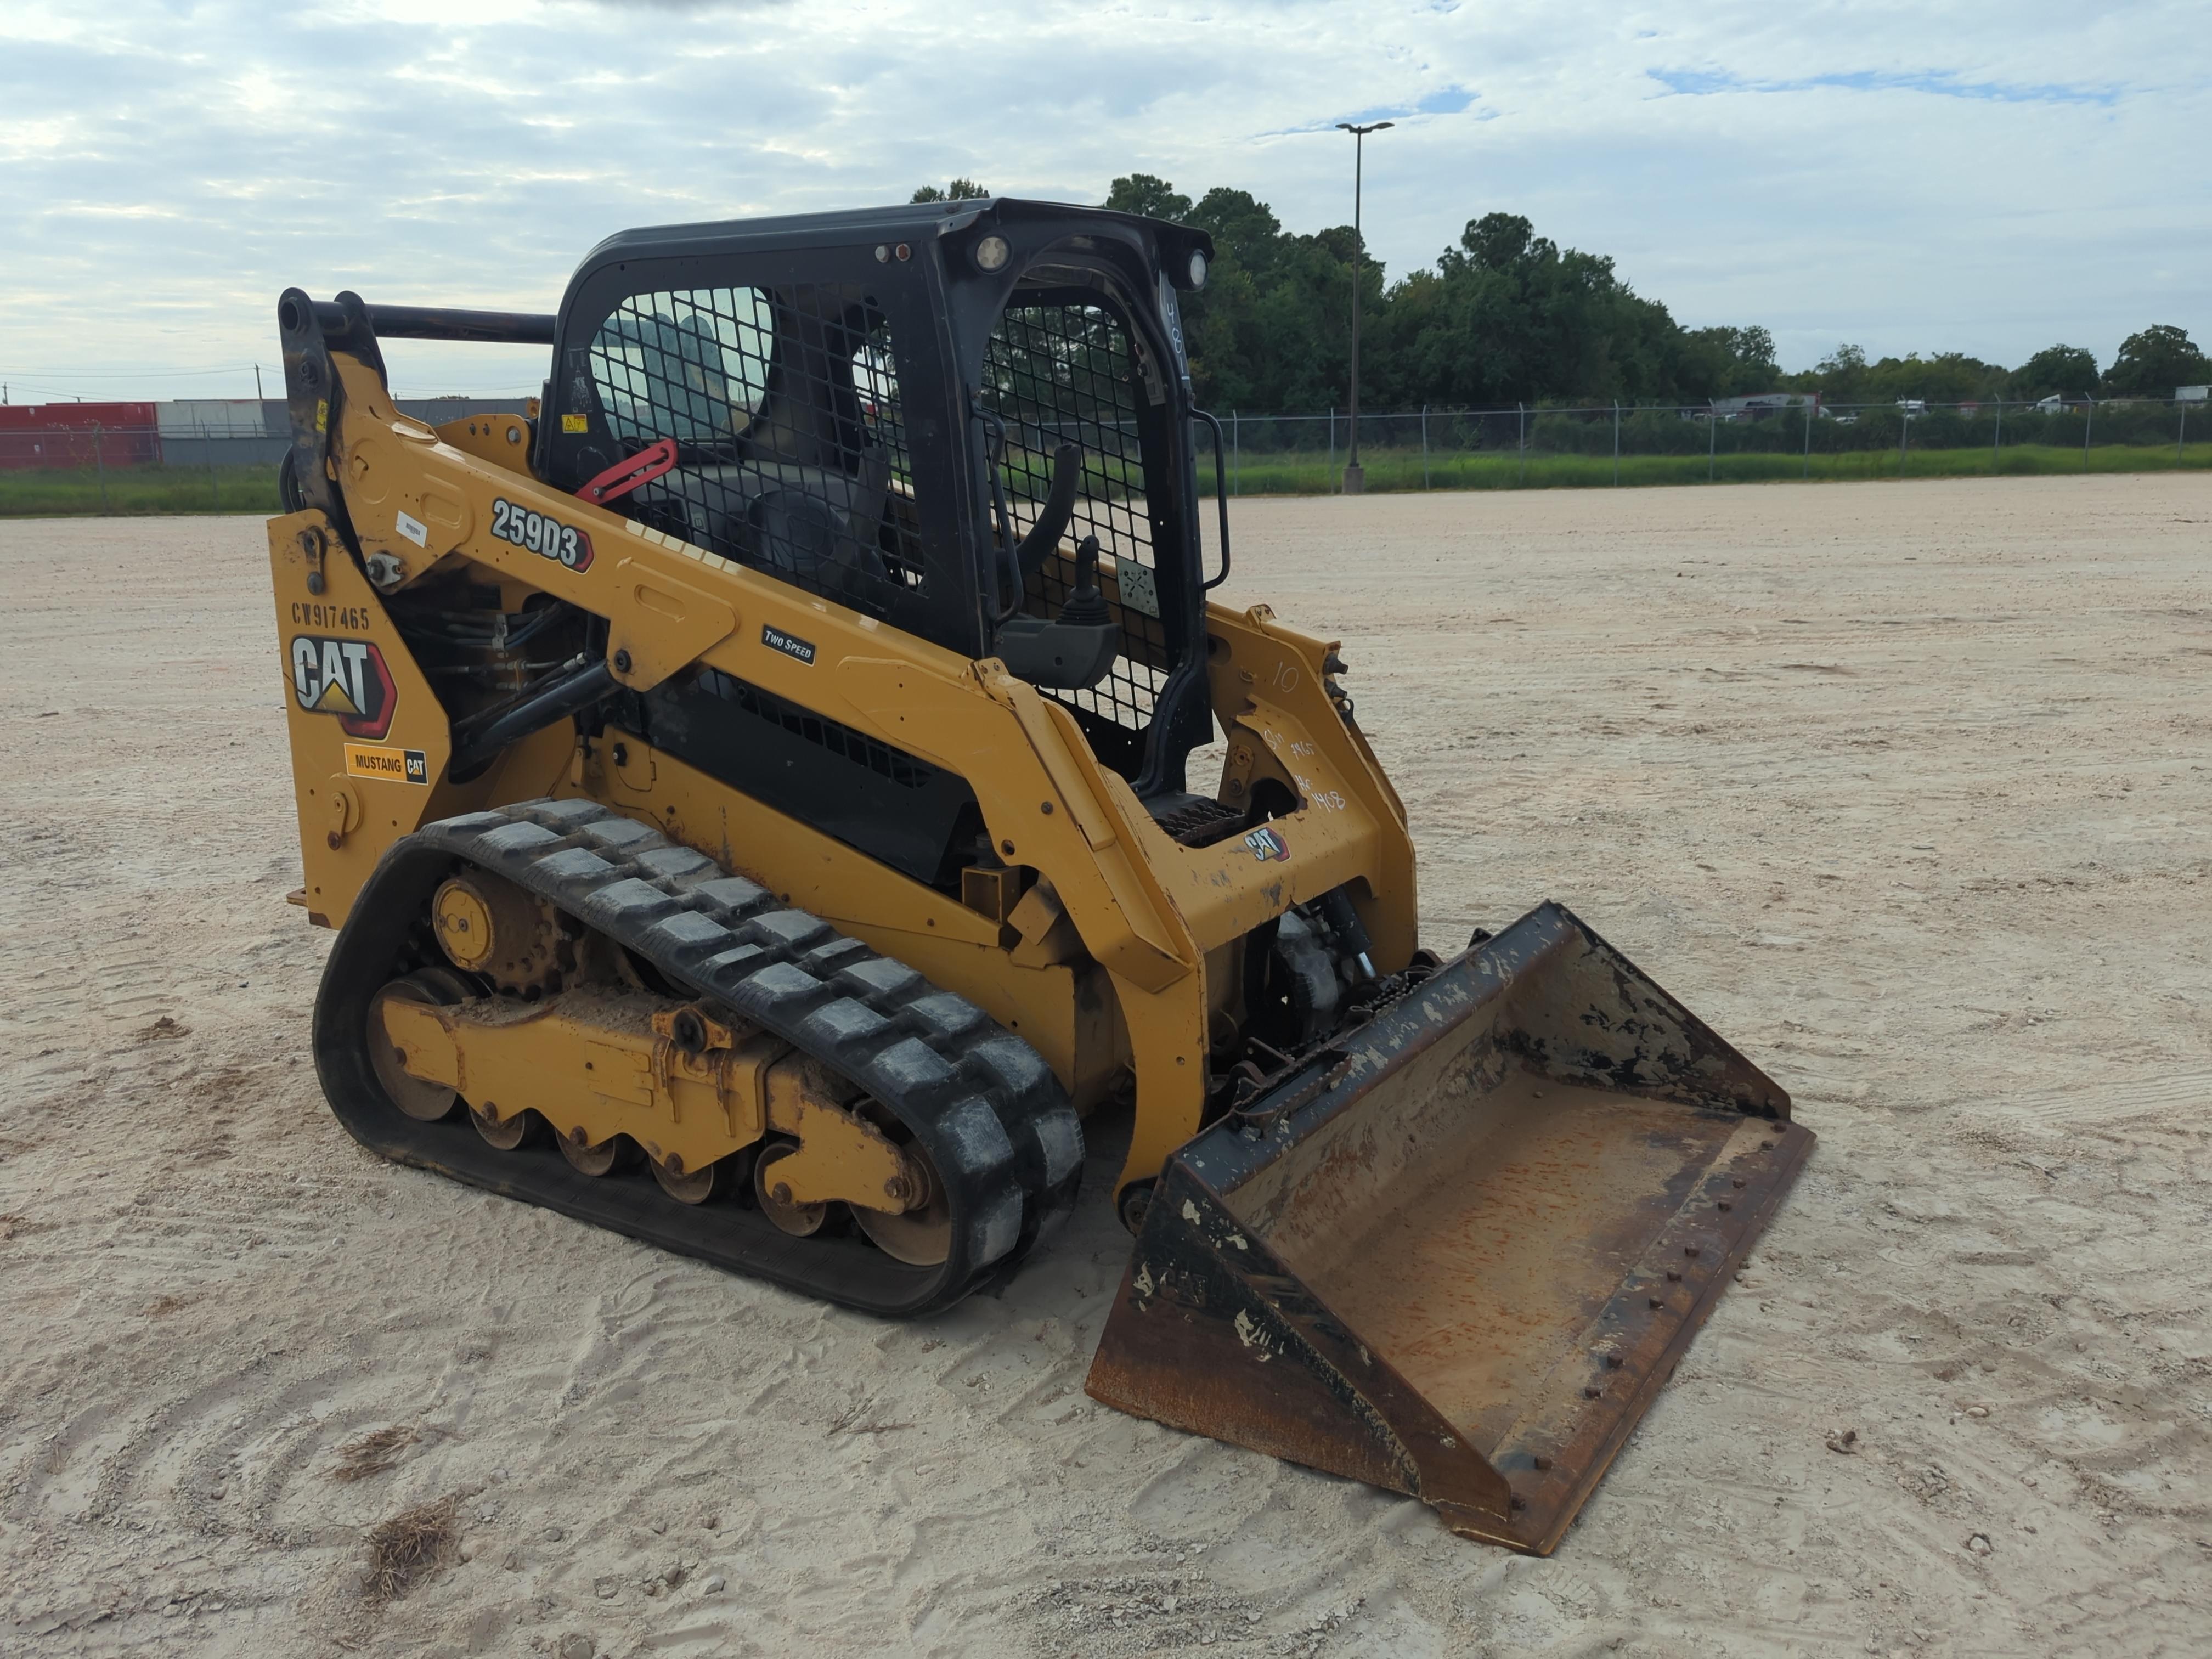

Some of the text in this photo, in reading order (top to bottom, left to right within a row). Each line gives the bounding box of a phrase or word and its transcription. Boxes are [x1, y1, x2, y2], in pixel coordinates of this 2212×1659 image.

[493, 500, 577, 565] 259D3
[292, 602, 369, 630] CW917465
[292, 637, 368, 715] CAT
[1273, 661, 1299, 692] 10
[356, 754, 424, 775] MUSTANG CAT
[1244, 829, 1280, 860] CAT
